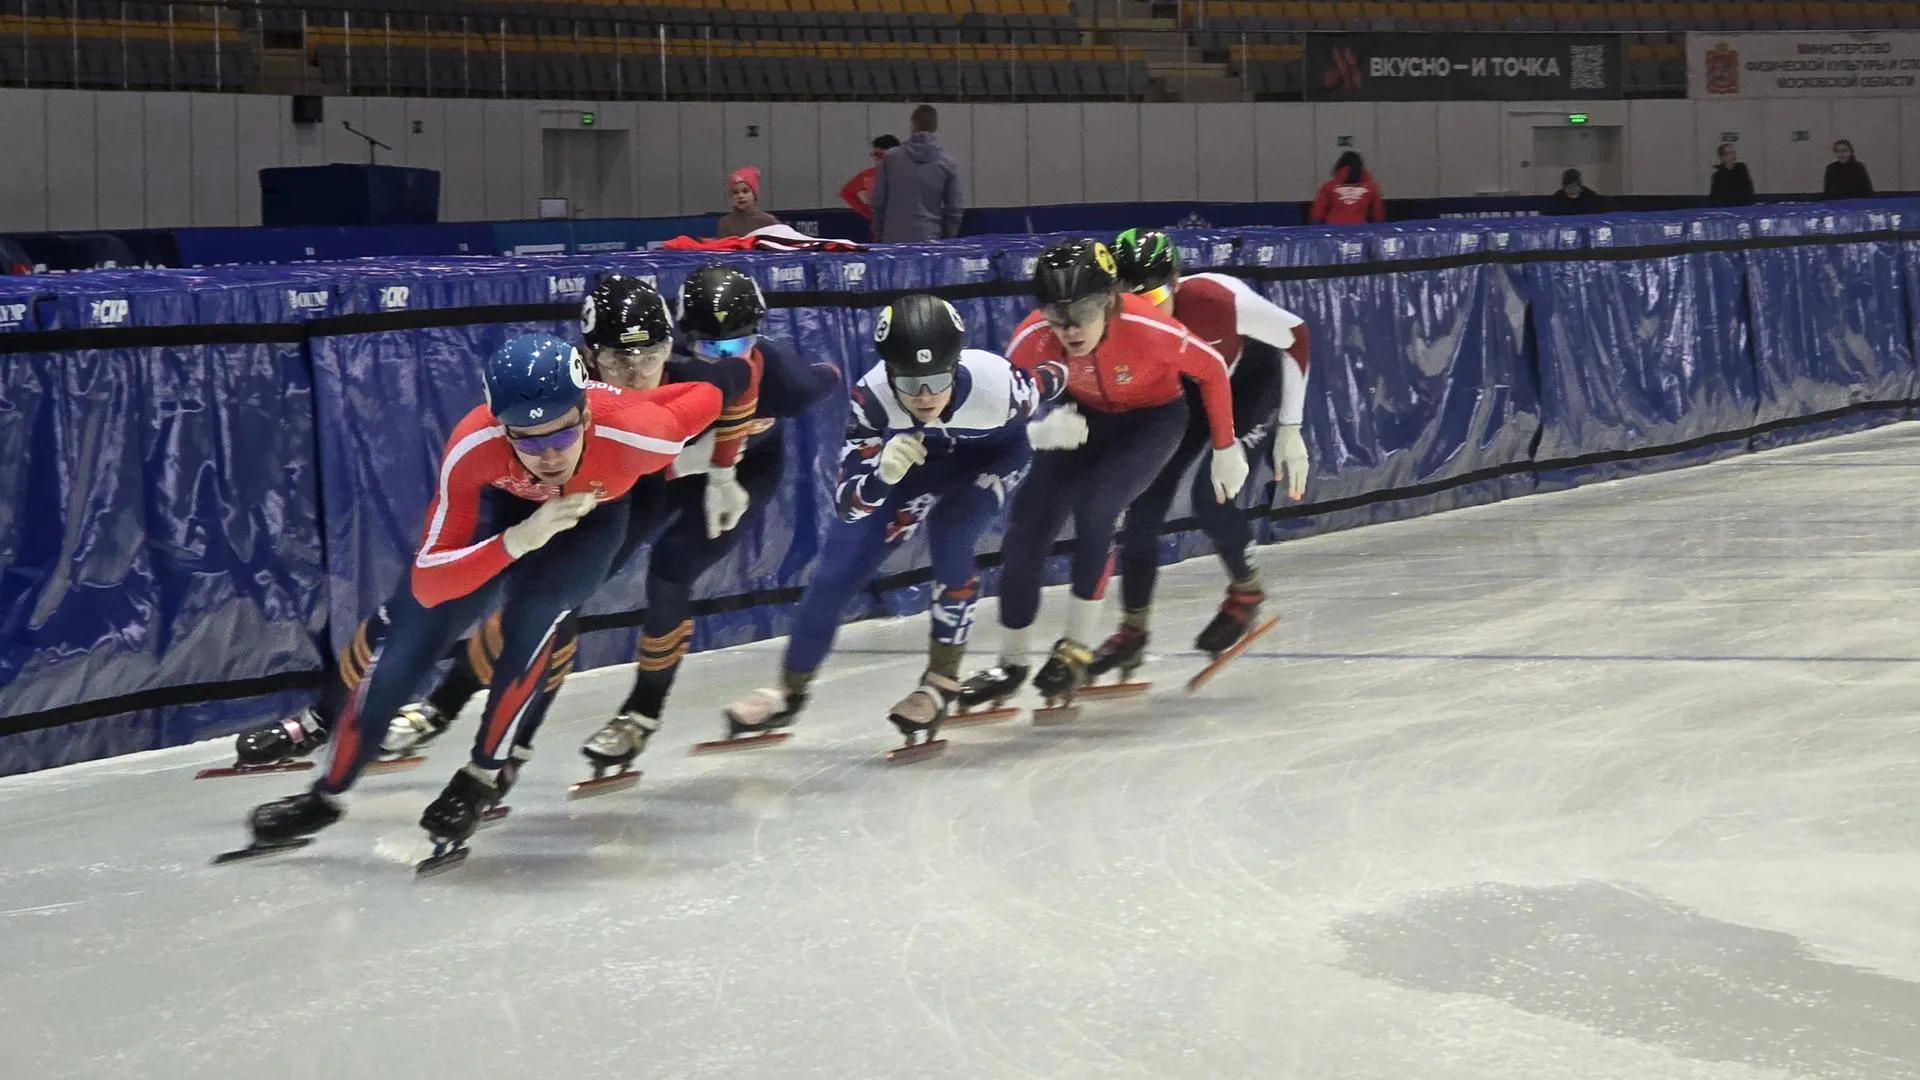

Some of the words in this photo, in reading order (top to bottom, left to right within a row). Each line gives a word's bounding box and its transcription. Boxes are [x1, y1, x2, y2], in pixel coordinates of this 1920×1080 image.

[1370, 57, 1450, 77] ВКУСНО
[1471, 57, 1487, 77] И
[1490, 57, 1561, 77] ТОЧКА
